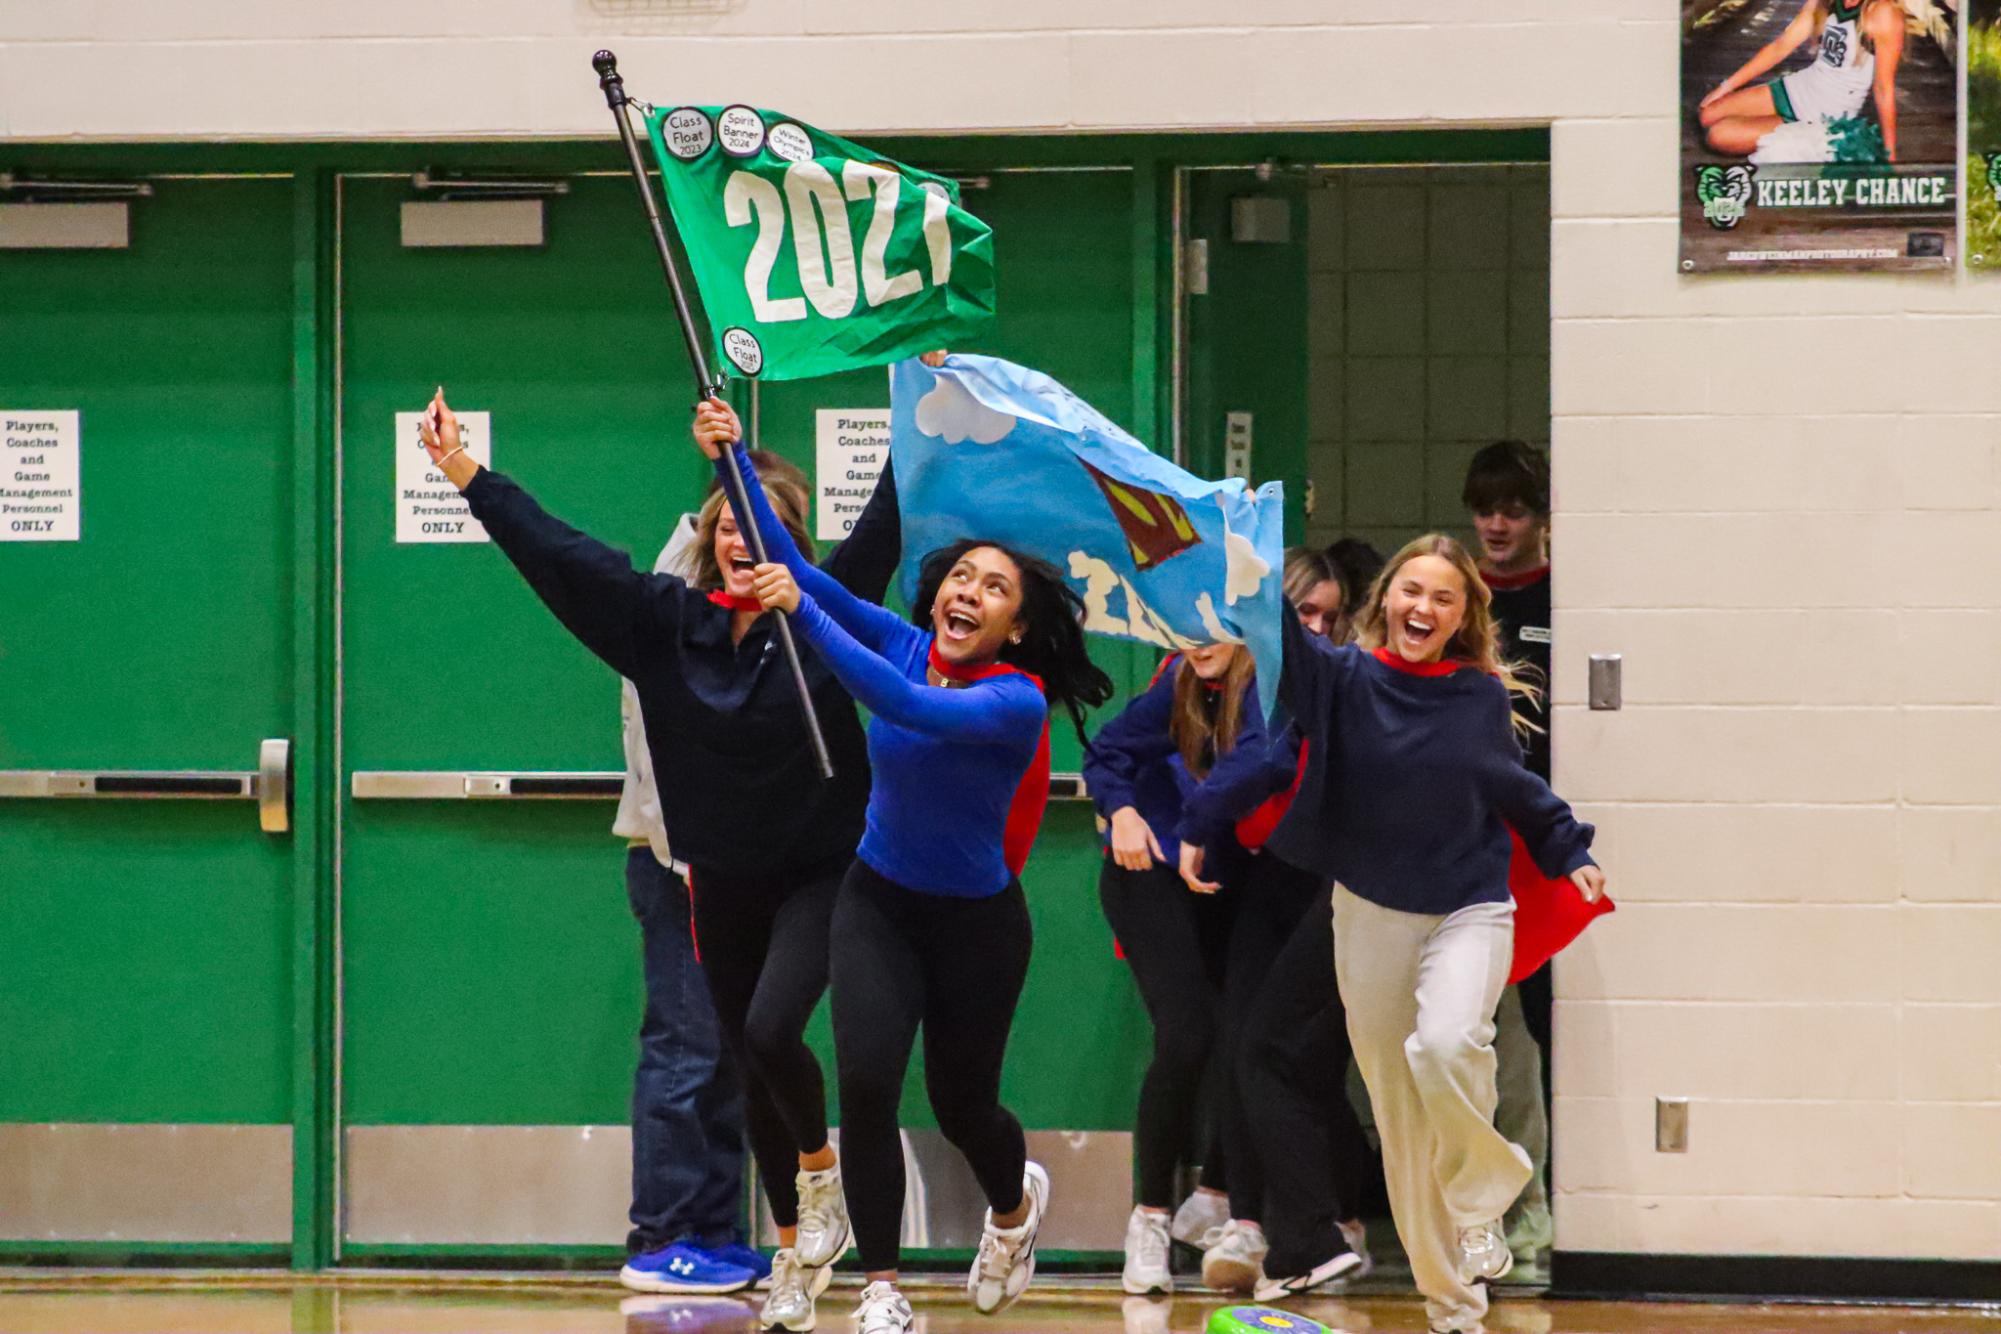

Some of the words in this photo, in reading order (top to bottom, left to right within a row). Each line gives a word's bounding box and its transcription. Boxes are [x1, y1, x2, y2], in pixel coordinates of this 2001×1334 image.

[670, 116, 702, 129] Class
[727, 112, 755, 127] Spirit
[673, 130, 704, 144] Float
[723, 124, 759, 140] Banner
[1757, 179, 1848, 207] KEELEY
[1855, 177, 1946, 205] CHANCE
[729, 333, 756, 348] Class
[733, 346, 758, 364] Float
[5, 420, 59, 433] Players,
[6, 437, 59, 448] Coaches
[838, 436, 891, 447] Coaches
[20, 454, 45, 465] and
[852, 453, 877, 463] and
[14, 471, 51, 482] Game
[403, 489, 463, 501] Managem
[824, 487, 873, 499] Manage
[2, 503, 63, 514] Personnel
[413, 505, 470, 515] Personne
[11, 520, 54, 532] ONLY
[421, 522, 465, 533] ONLY
